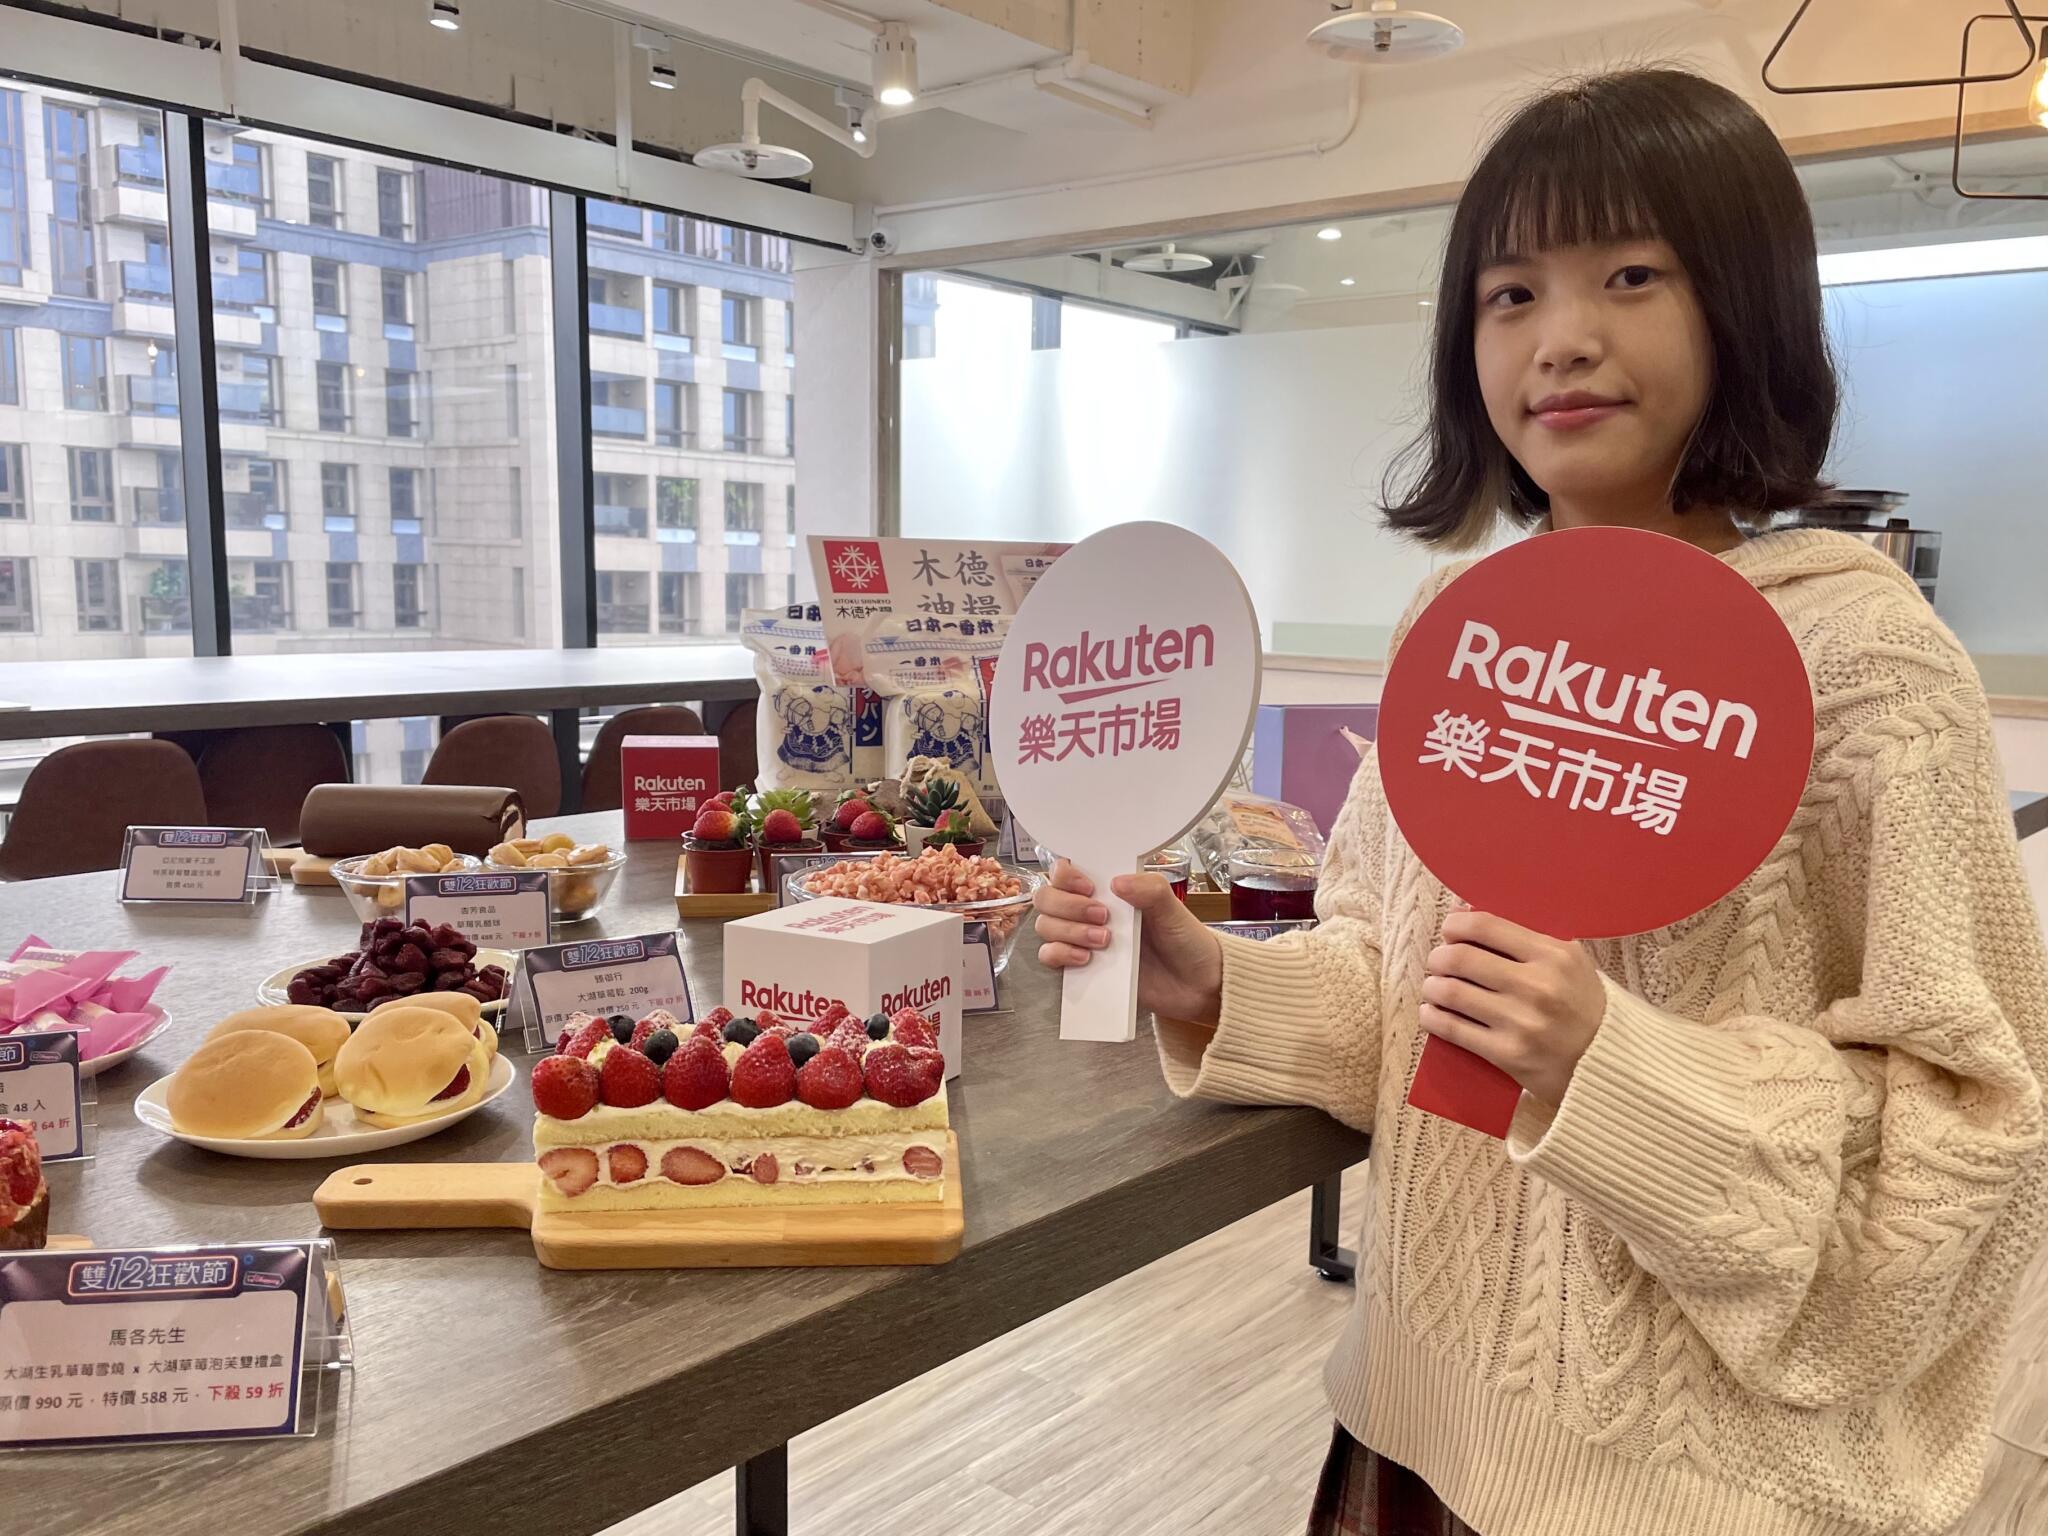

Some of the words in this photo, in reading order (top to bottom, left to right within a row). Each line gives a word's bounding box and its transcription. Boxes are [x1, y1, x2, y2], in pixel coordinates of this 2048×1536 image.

[912, 549, 996, 587] 木德
[1022, 624, 1214, 692] Rakuten
[1447, 619, 1758, 760] Rakuten
[1018, 697, 1181, 765] 樂天市場
[634, 775, 705, 791] Rakuten
[1418, 708, 1688, 835] 樂天市場
[635, 797, 696, 812] 樂天市場
[444, 876, 512, 892] 雙12狂歡節
[567, 943, 639, 965] 雙12狂歡節
[629, 986, 649, 995] 200g
[881, 975, 950, 1016] Rakuten
[79, 1256, 229, 1291] 雙12狂歡節
[109, 1328, 187, 1346] 馬各先生
